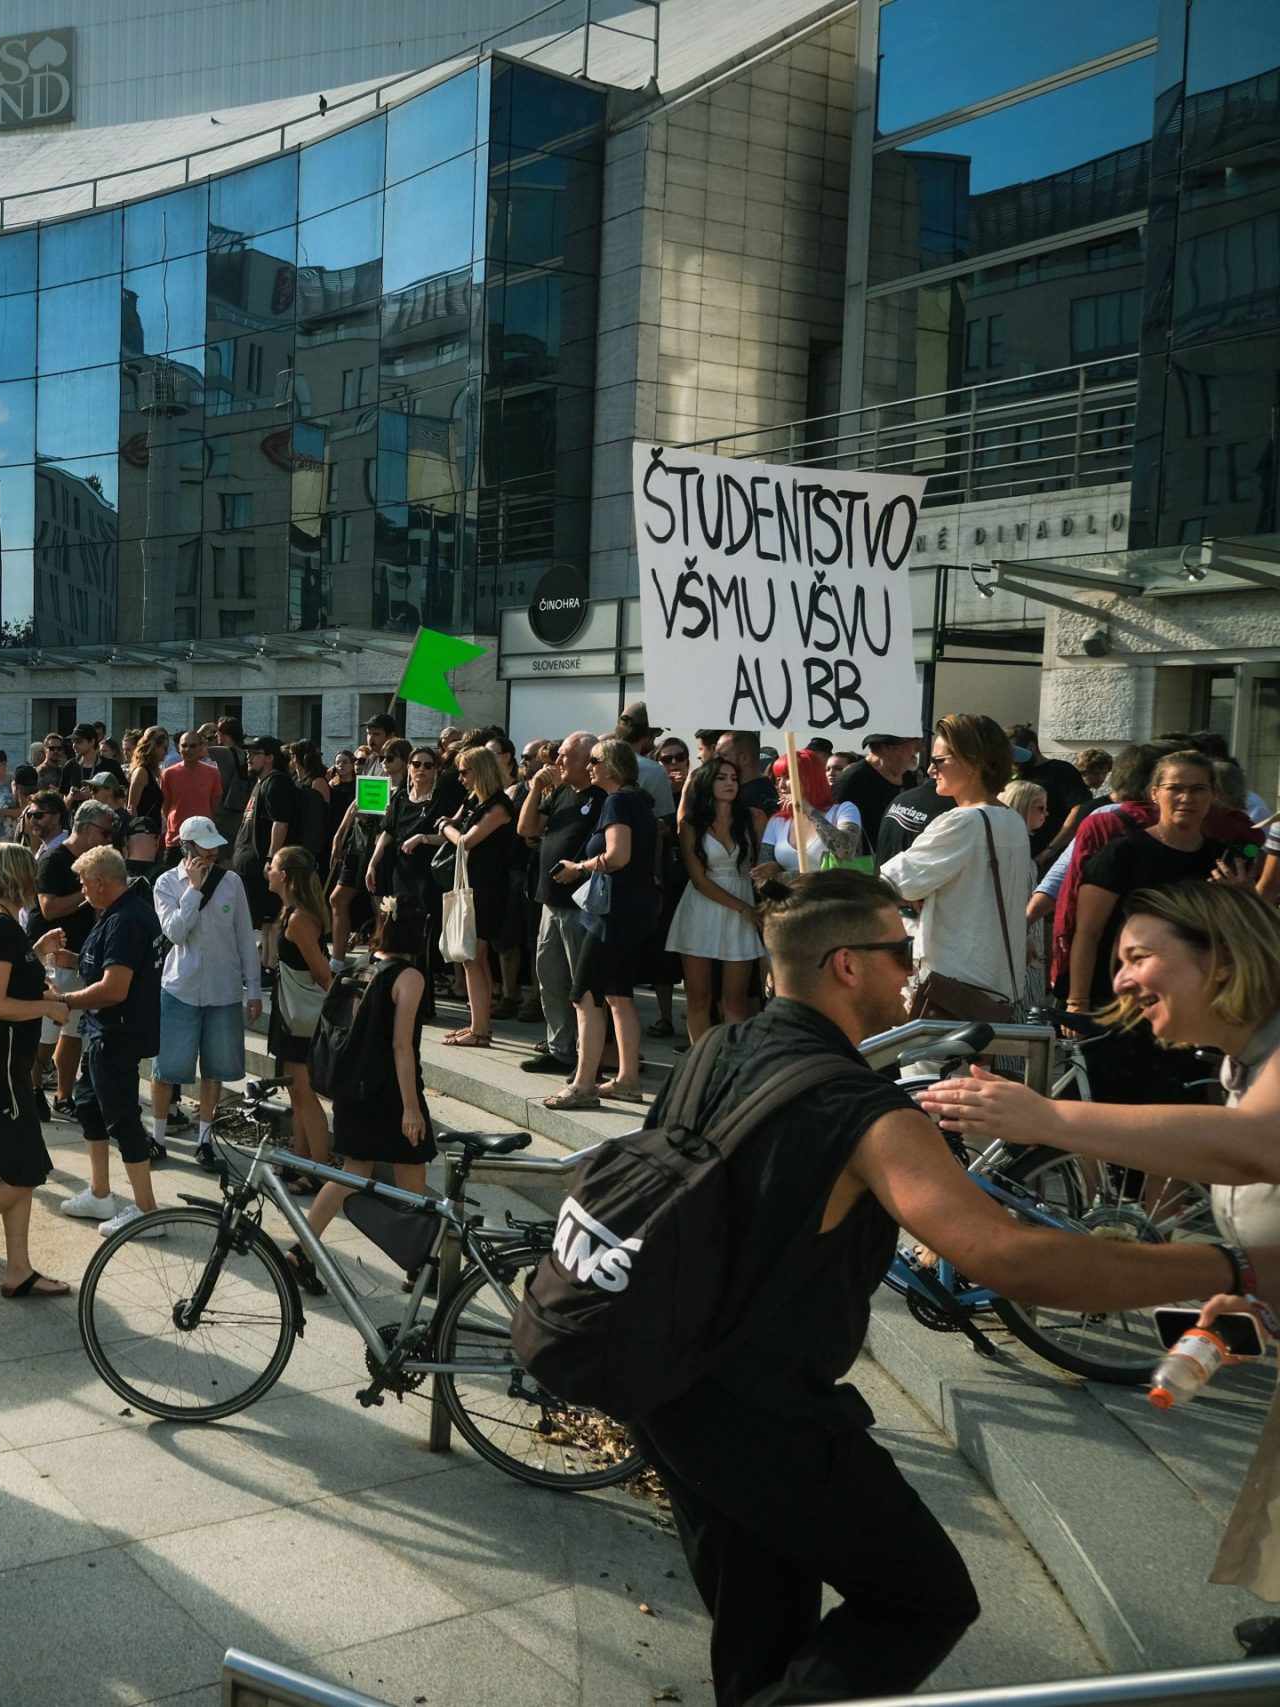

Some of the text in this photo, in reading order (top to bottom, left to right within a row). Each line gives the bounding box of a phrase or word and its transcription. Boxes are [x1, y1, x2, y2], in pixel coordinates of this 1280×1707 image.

[643, 447, 918, 571] ŠTUDENTSTVO
[974, 511, 1126, 546] DIVADLO
[539, 598, 580, 611] ČINOHRA
[651, 556, 892, 657] VŠMU VŠVU
[531, 656, 581, 672] SLOVENSKÉ
[730, 654, 870, 731] AU BB
[552, 1195, 644, 1293] VANS
